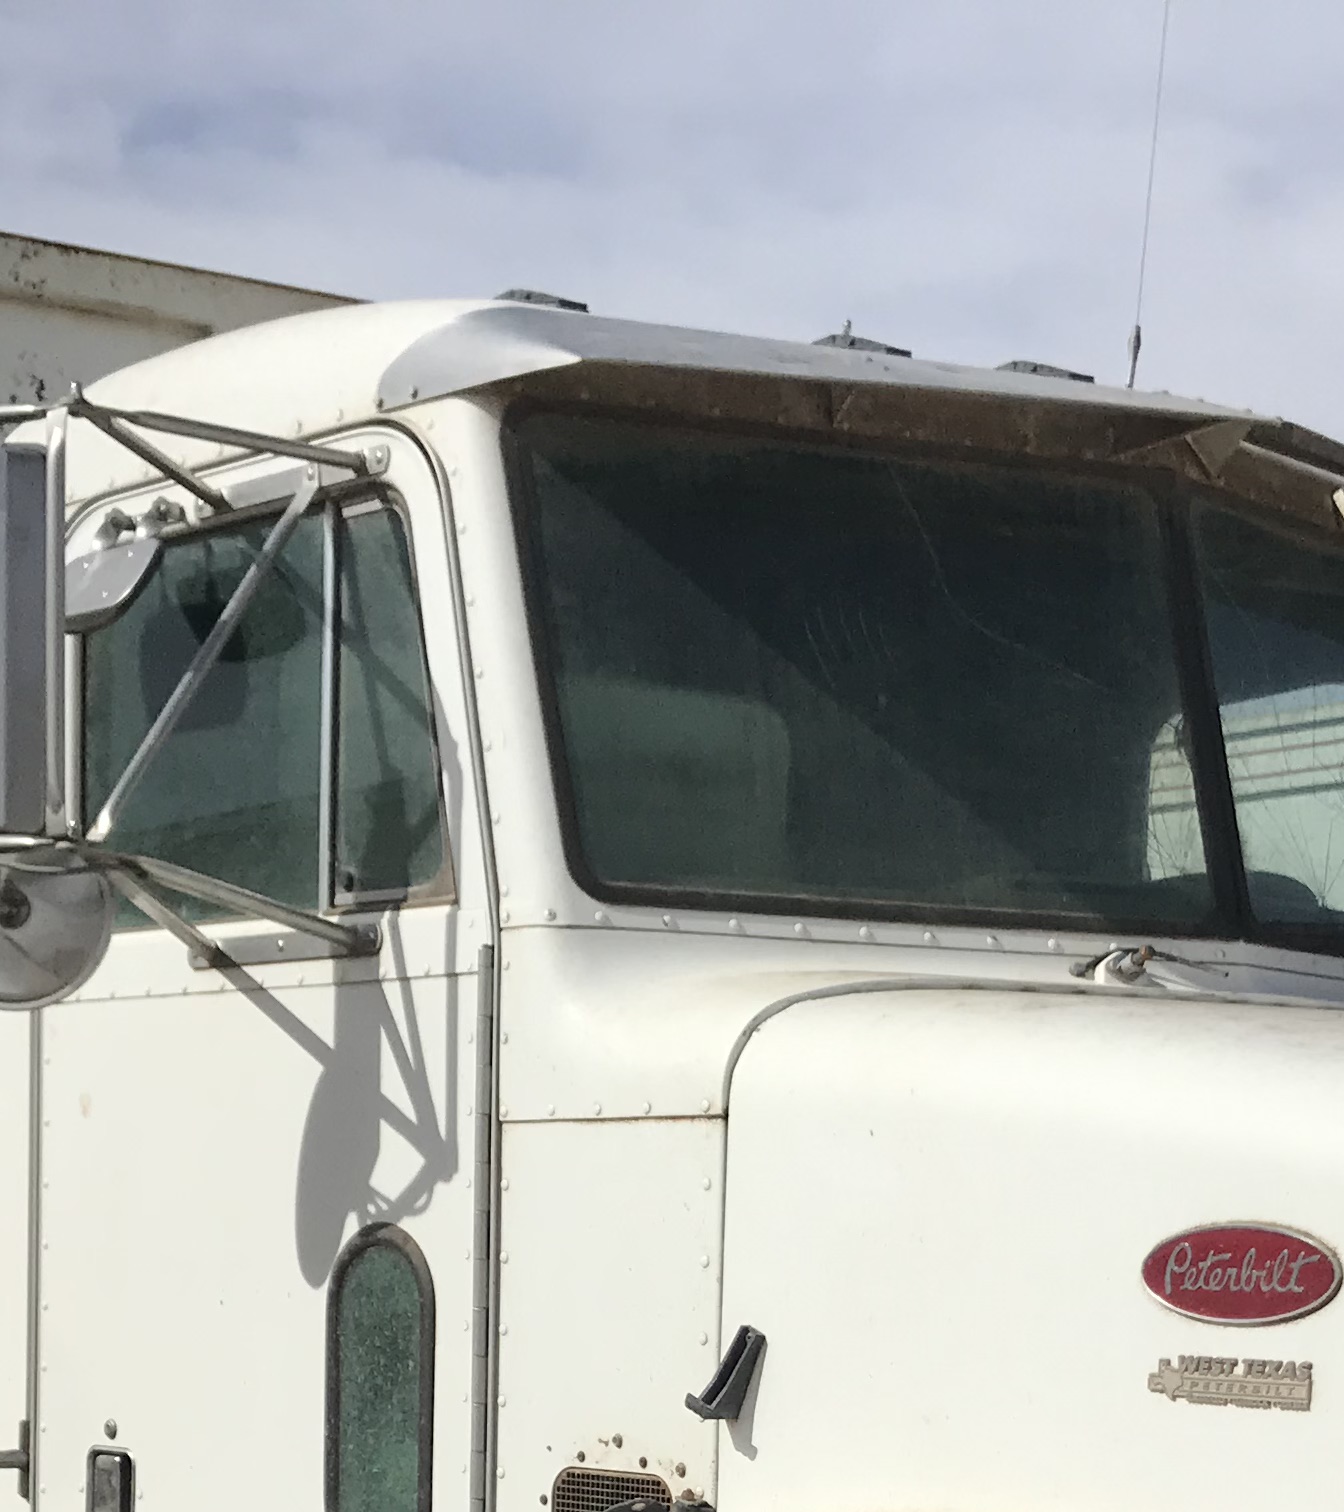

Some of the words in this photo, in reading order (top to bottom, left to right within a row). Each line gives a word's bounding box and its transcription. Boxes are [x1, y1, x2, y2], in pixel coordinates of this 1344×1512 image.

[1164, 1241, 1321, 1296] Peterbilt
[1178, 1354, 1239, 1377] WEST
[1241, 1358, 1313, 1382] TEXAS
